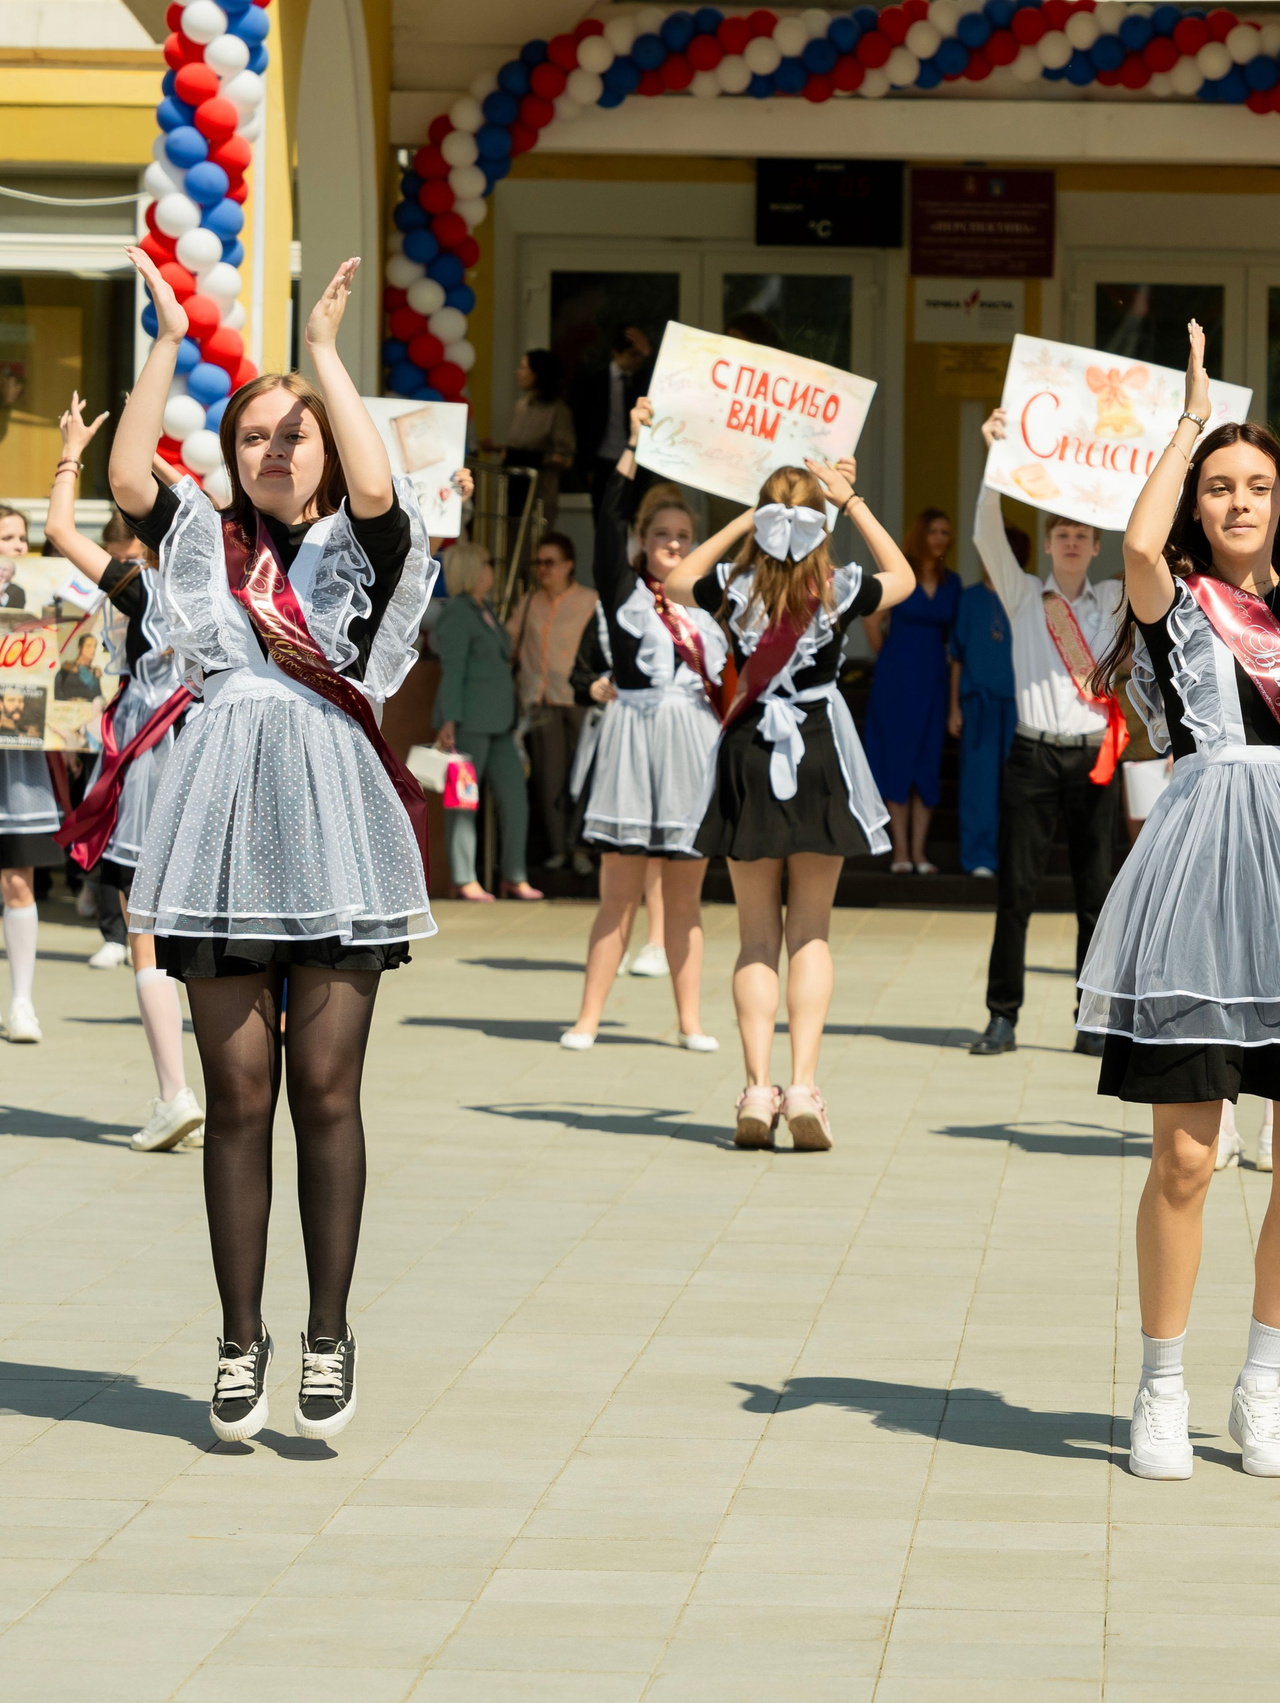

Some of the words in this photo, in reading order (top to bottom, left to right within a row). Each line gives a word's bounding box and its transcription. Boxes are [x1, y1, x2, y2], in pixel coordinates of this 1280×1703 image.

[711, 359, 840, 424] СПАСИБО
[725, 399, 782, 443] ВАМ
[1020, 391, 1157, 478] Спаси
